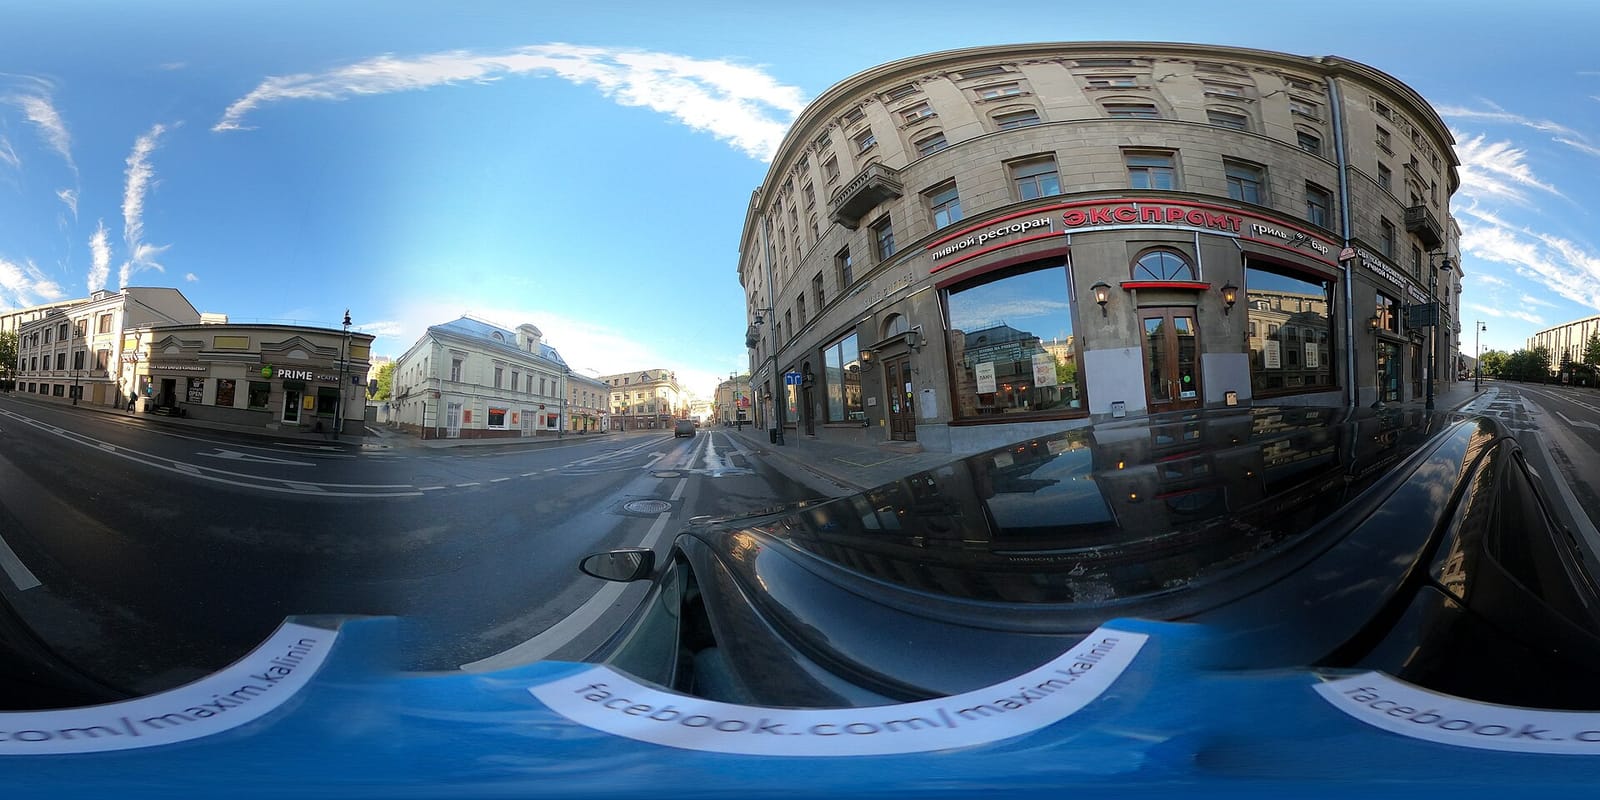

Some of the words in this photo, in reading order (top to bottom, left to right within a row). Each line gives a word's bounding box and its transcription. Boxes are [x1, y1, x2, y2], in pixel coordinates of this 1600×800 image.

[1063, 206, 1243, 233] ЭКСПРОМТ
[932, 236, 975, 261] пивной
[978, 217, 1050, 245] ресторан
[1252, 223, 1287, 240] гриль
[1311, 240, 1329, 255] бар
[277, 369, 313, 381] PRIME
[573, 635, 1120, 737] facebook.com/maxim.kalinin
